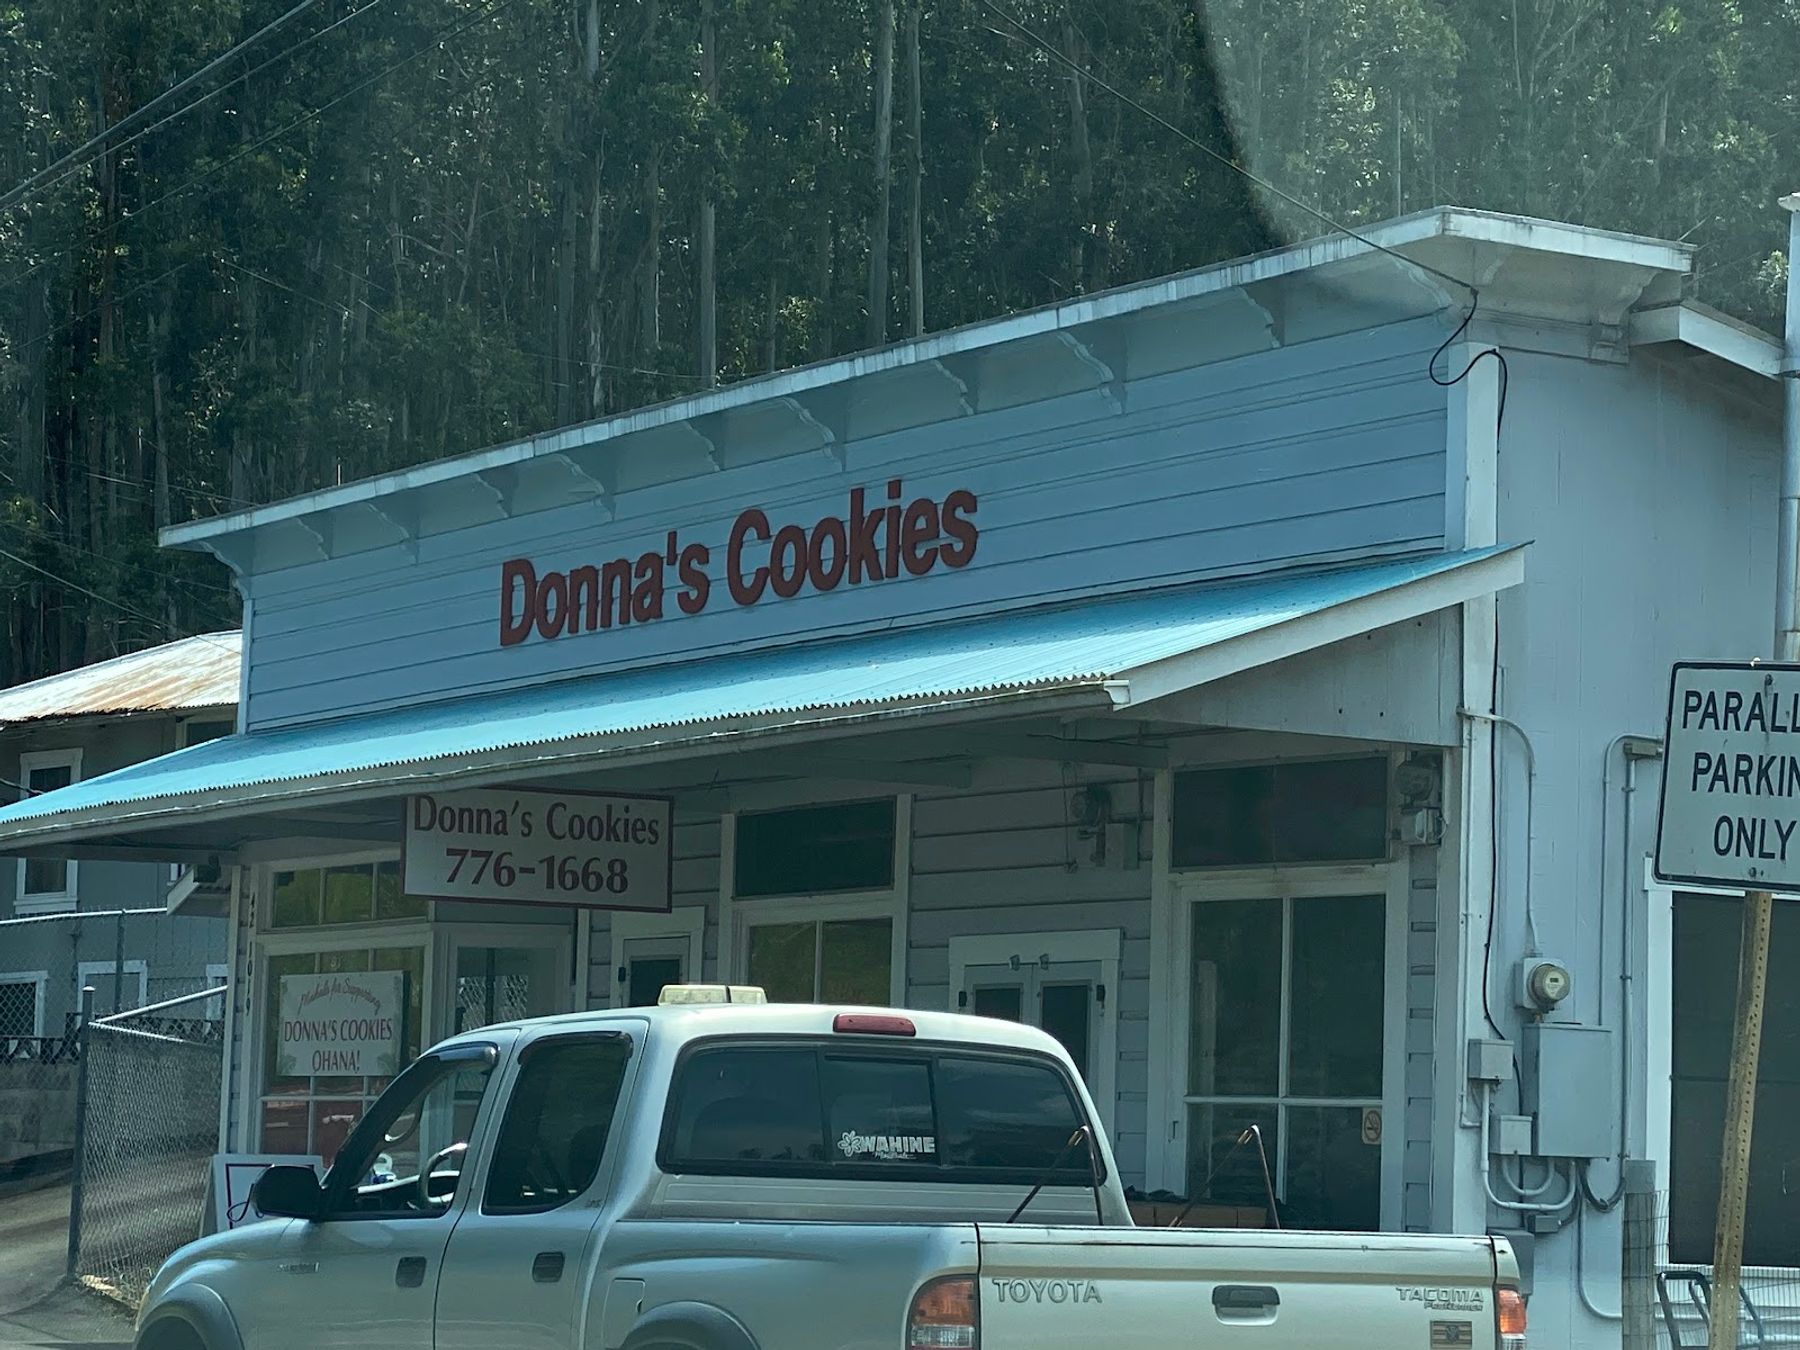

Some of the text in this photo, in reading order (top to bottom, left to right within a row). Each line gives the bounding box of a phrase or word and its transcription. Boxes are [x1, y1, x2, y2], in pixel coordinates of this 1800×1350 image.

[499, 479, 978, 646] Donna's Cookies
[413, 794, 659, 845] Donna's Cookies
[1713, 815, 1797, 860] ONLY
[446, 847, 629, 894] 776-1668
[284, 1018, 393, 1042] DONNA'S COOKIES
[312, 1050, 361, 1072] OHANA!
[859, 1135, 936, 1153] WAHINE
[991, 1278, 1103, 1304] TOYOTA
[1395, 1287, 1484, 1303] TACOMA
